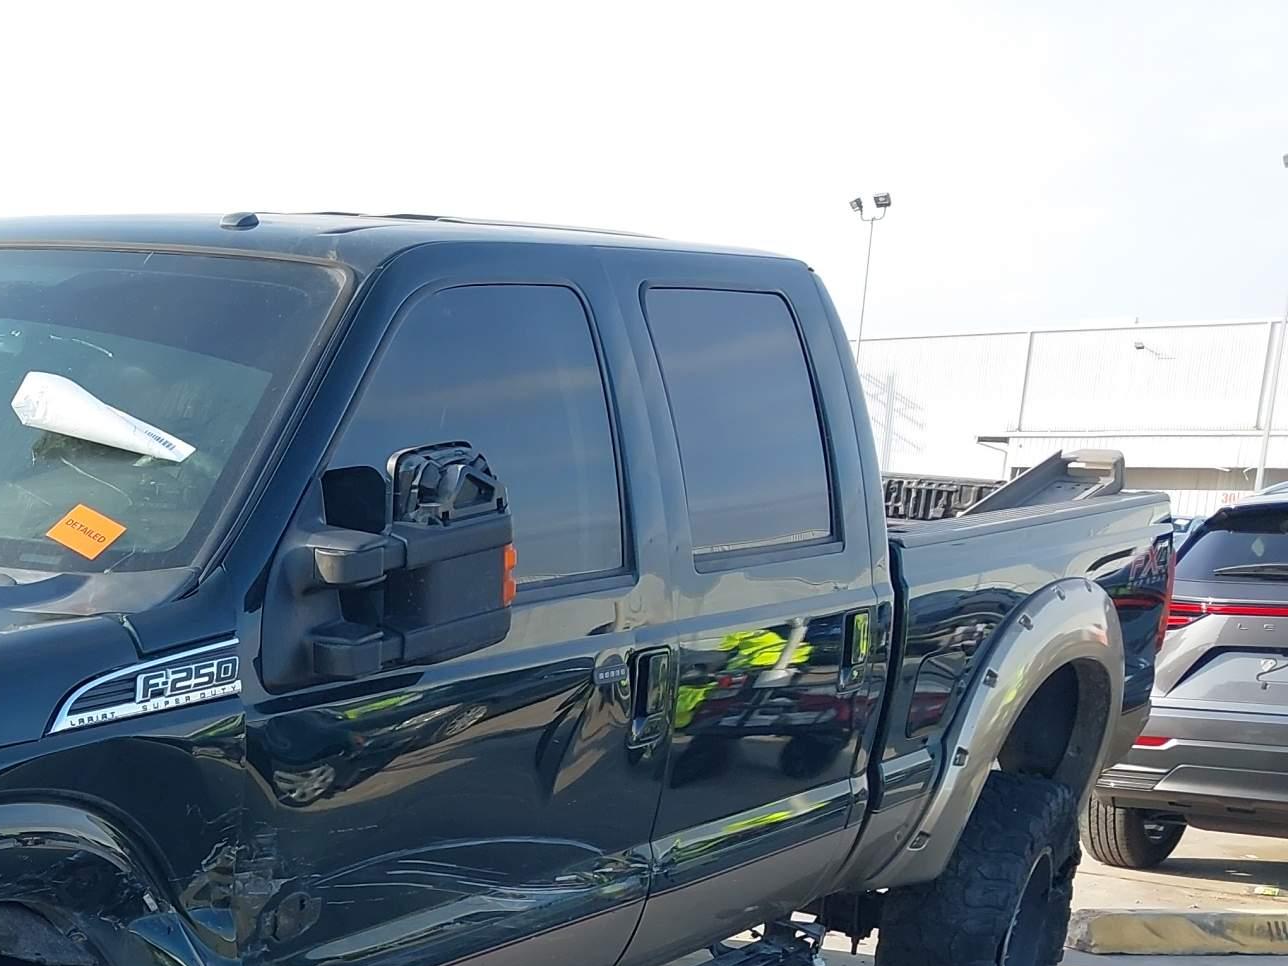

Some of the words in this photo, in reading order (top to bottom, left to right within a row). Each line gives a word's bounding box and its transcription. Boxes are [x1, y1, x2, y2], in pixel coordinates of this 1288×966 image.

[65, 518, 106, 544] DETAILED
[135, 656, 240, 703] F-250
[69, 711, 117, 727] LARIAT
[141, 695, 192, 713] SUPER
[199, 685, 239, 700] DUTY
